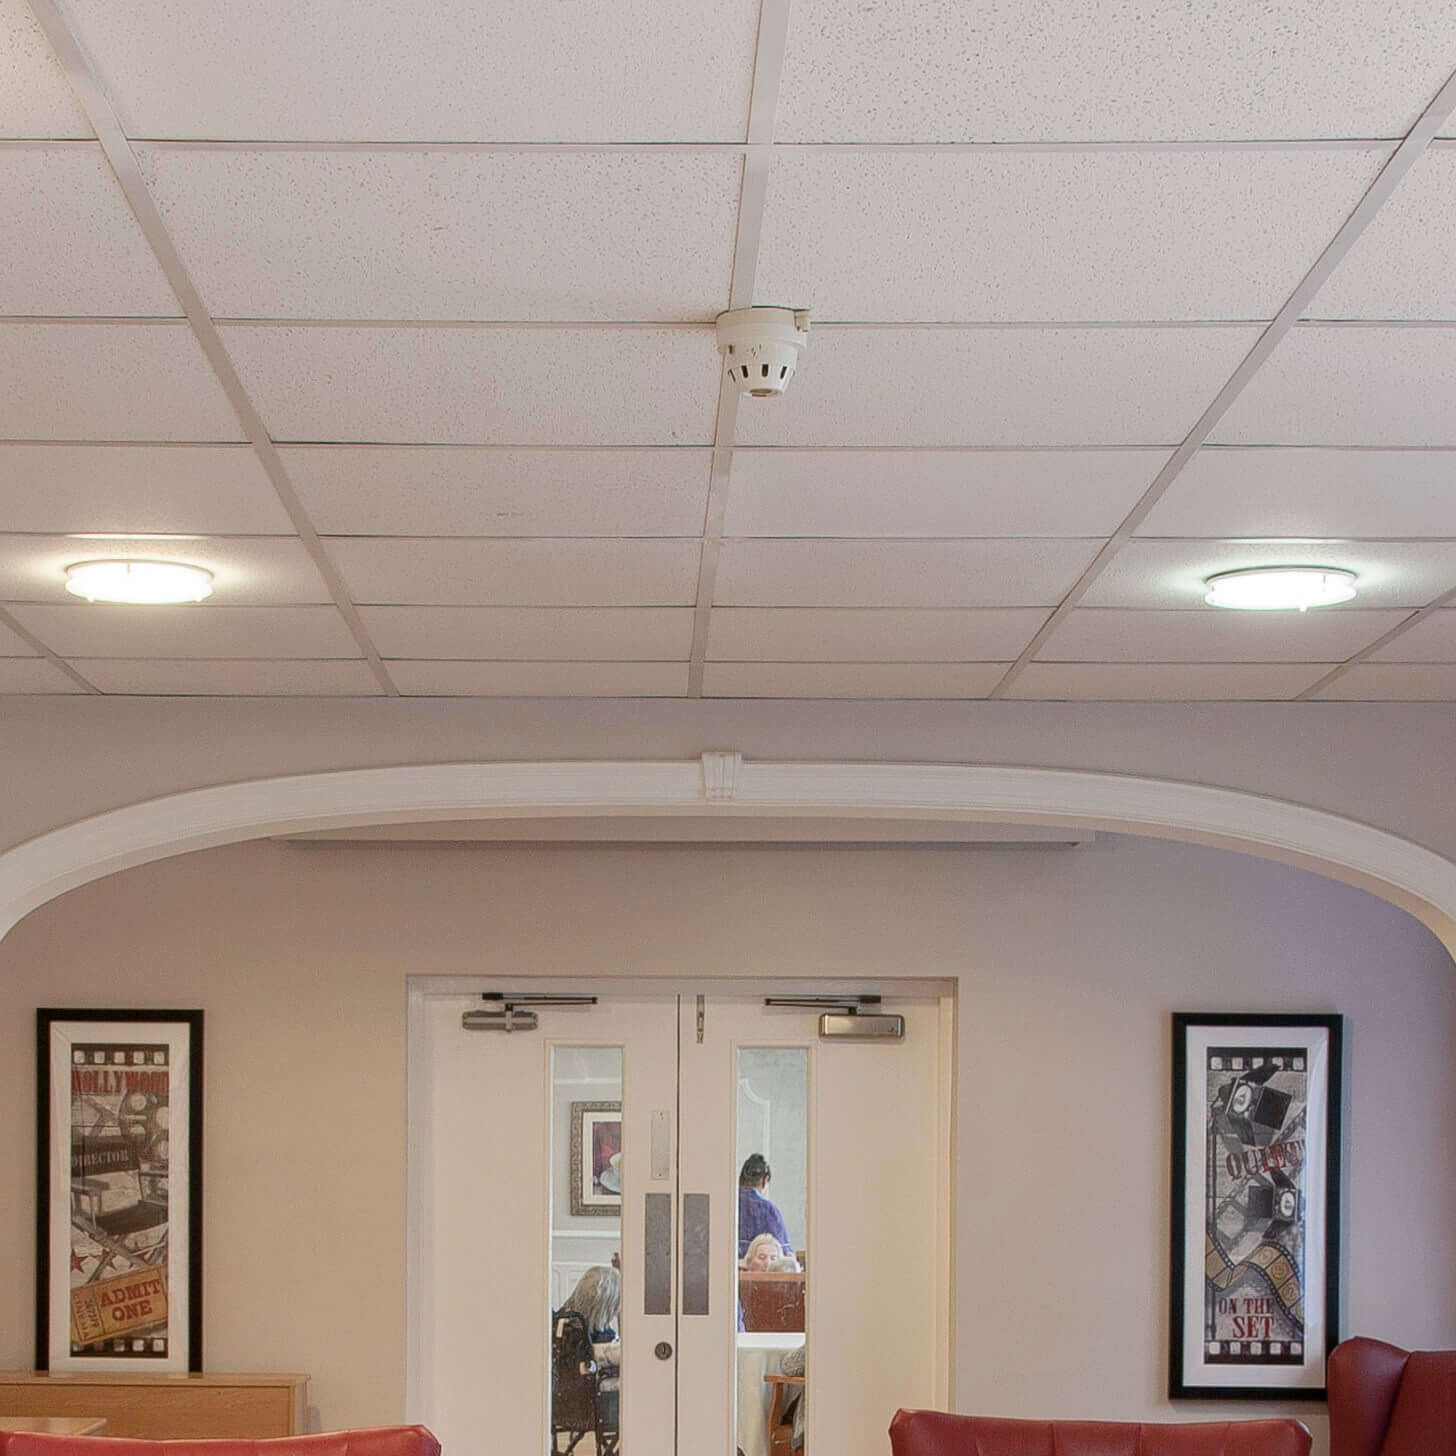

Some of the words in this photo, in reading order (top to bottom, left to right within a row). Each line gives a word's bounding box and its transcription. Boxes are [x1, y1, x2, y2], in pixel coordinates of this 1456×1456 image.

[71, 1070, 169, 1094] HOLLYWOOD
[71, 1150, 130, 1168] DIRECTOR
[100, 1279, 161, 1307] ADMIT
[111, 1300, 153, 1321] ONE
[1219, 1297, 1238, 1314] ON
[1243, 1297, 1274, 1314] THE
[1232, 1315, 1274, 1338] SET
